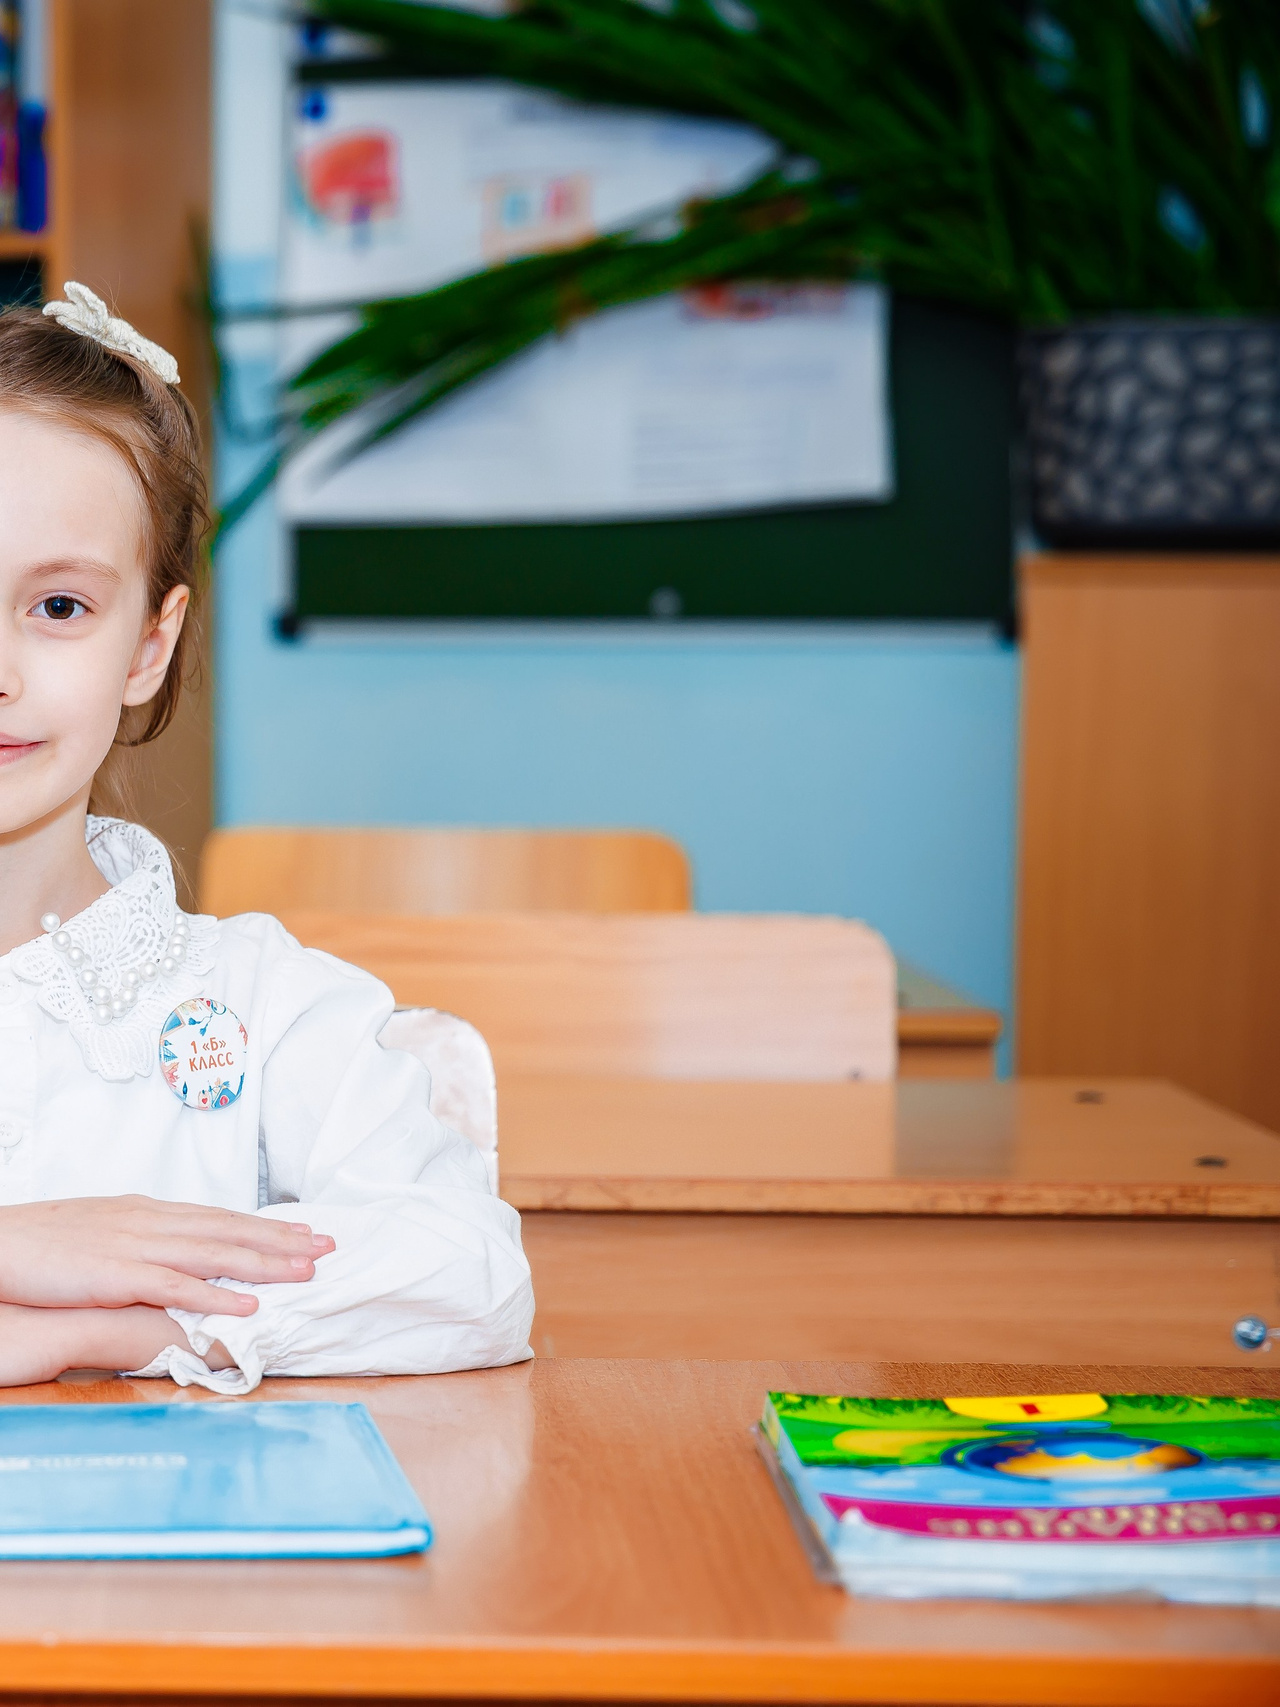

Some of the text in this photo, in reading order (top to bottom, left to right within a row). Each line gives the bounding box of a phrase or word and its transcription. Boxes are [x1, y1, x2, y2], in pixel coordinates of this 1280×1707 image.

[190, 1037, 227, 1054] 1 «Б»
[188, 1051, 235, 1072] КЛАСС
